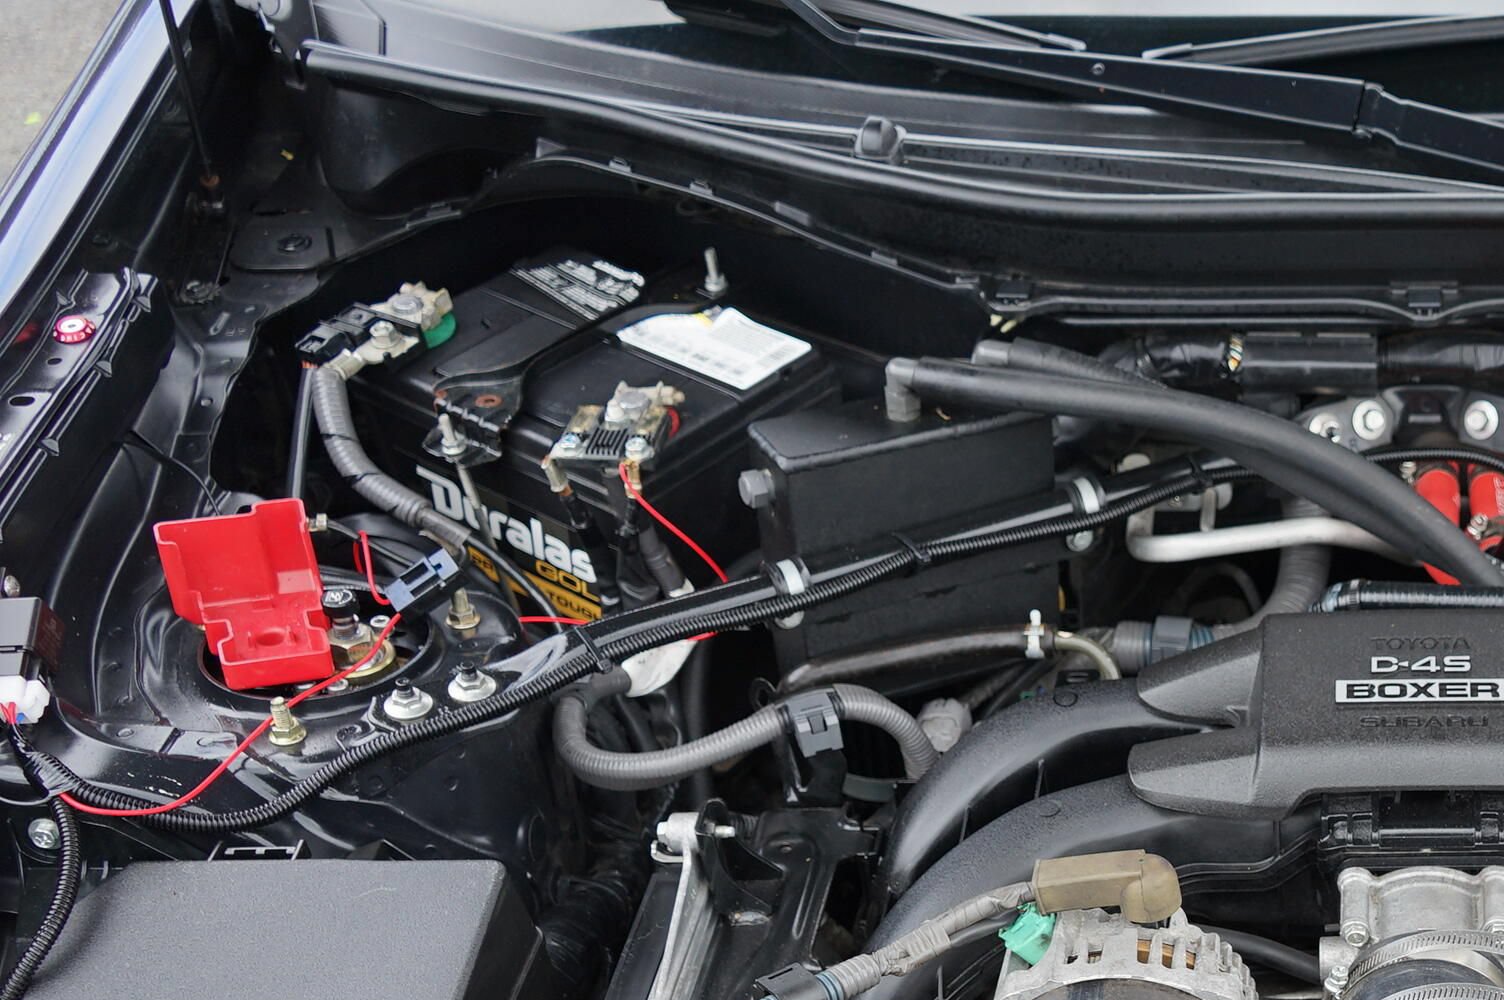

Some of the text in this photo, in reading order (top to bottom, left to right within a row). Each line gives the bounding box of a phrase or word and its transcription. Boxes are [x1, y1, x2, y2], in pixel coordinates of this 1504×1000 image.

[1371, 637, 1471, 650] TOYOTA
[1371, 655, 1471, 672] D-4S
[1346, 682, 1500, 699] BOXER
[1360, 715, 1489, 728] SUBARU
